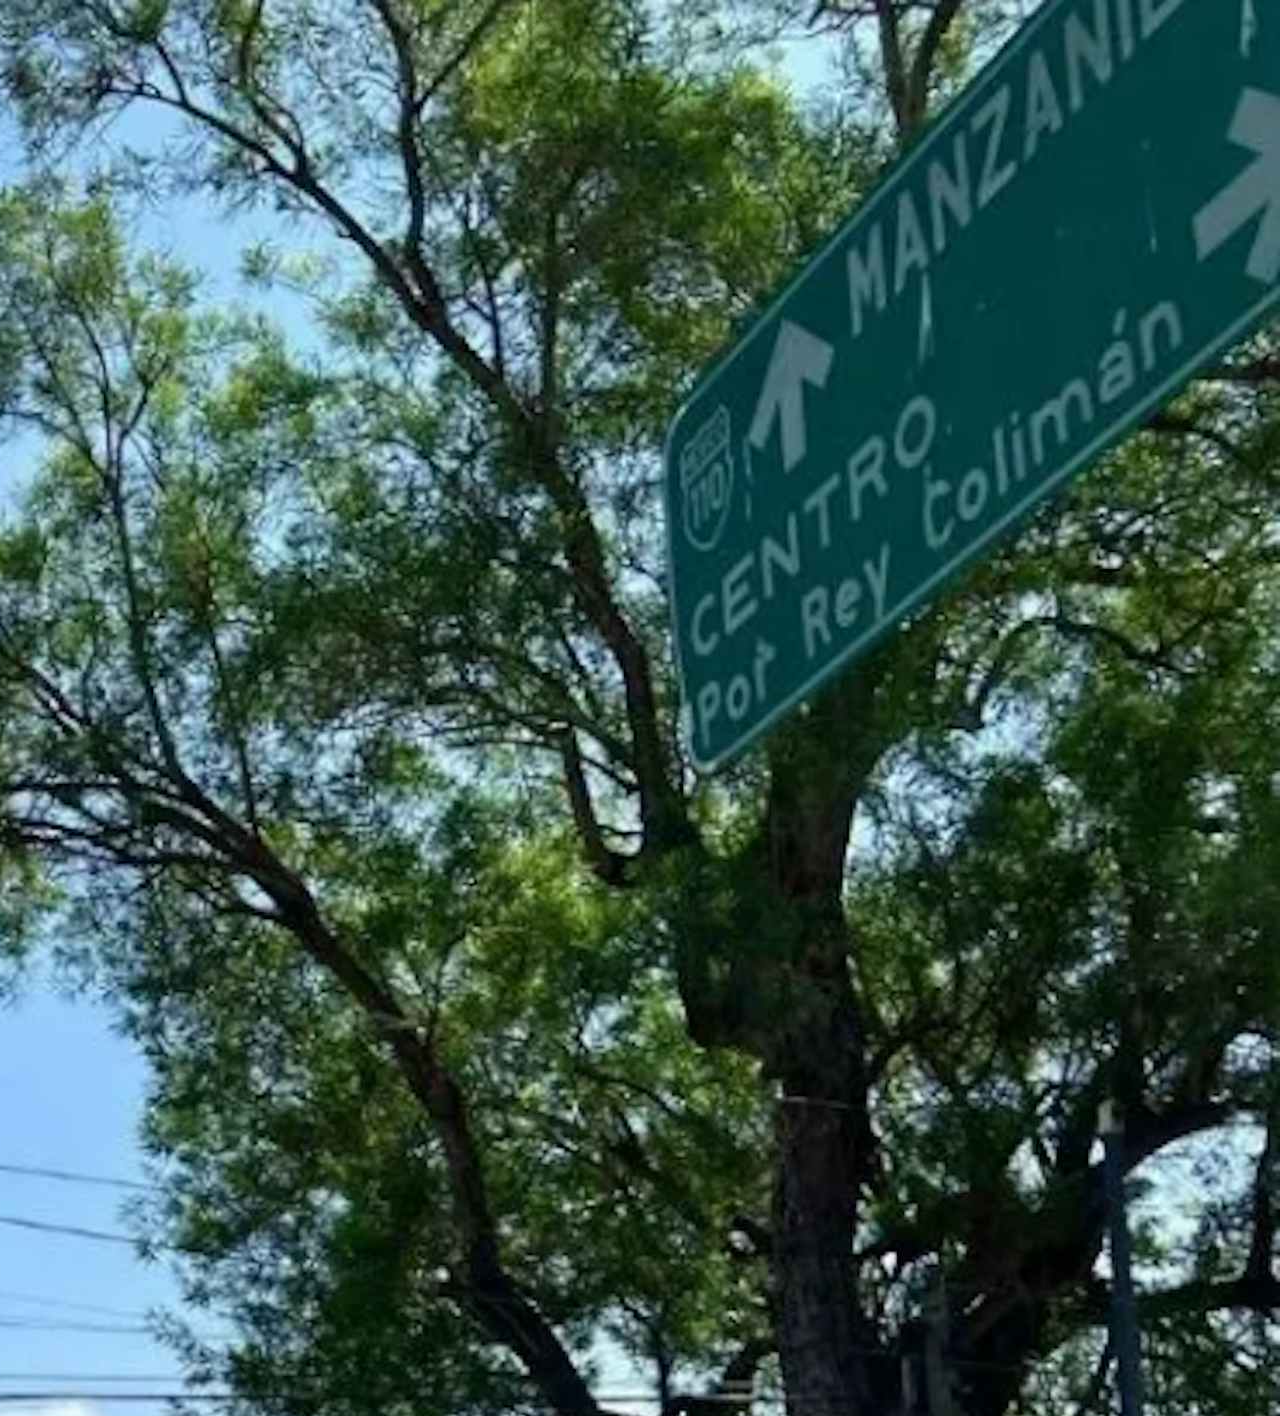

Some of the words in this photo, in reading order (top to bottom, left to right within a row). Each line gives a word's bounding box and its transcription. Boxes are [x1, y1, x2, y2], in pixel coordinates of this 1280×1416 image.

[690, 462, 725, 530] 110
[692, 396, 937, 656] CENTRO
[697, 643, 776, 748] Por
[801, 542, 891, 658] Rey
[923, 301, 1183, 548] Colimán
